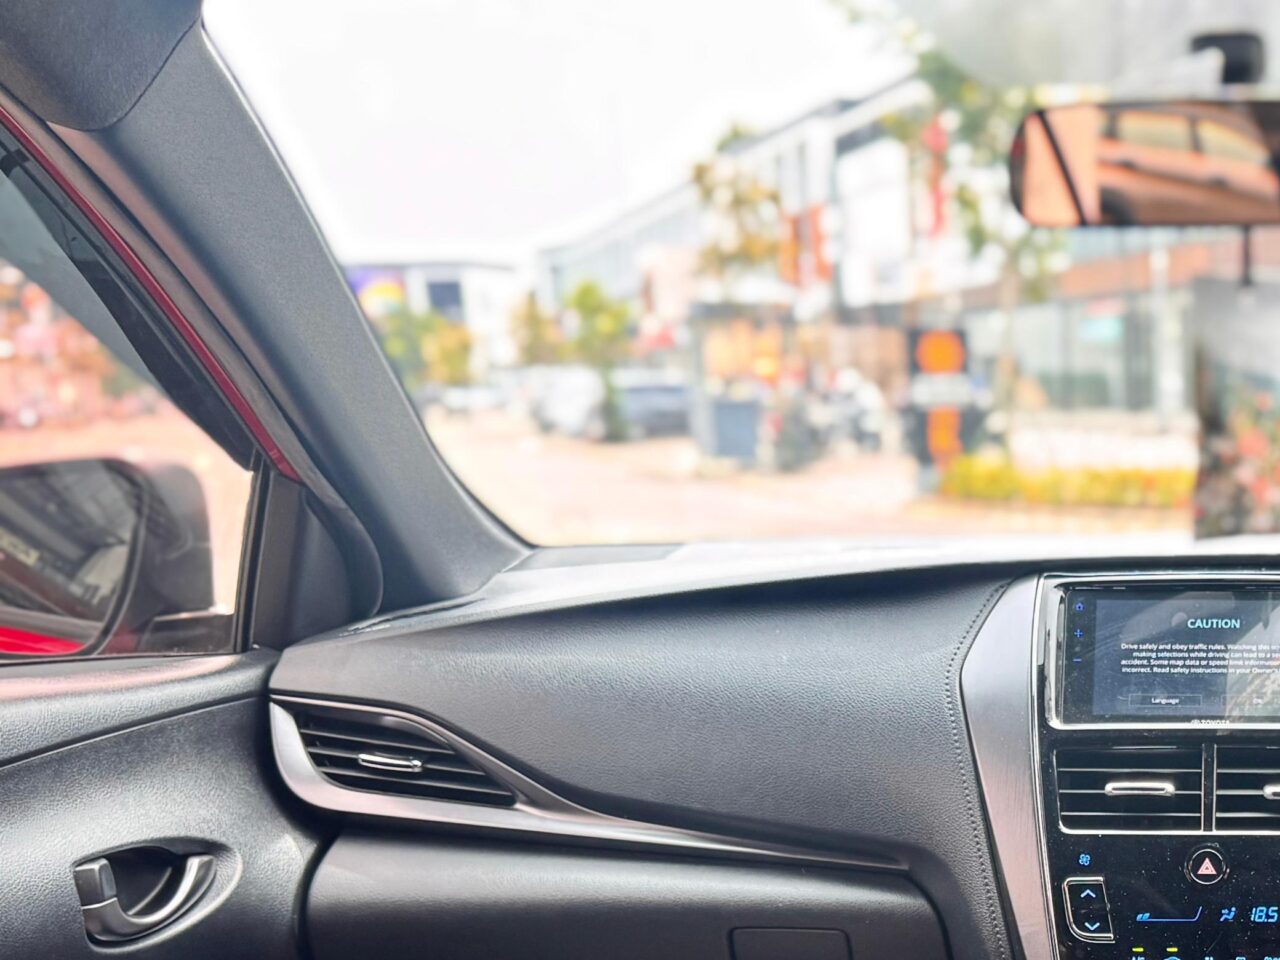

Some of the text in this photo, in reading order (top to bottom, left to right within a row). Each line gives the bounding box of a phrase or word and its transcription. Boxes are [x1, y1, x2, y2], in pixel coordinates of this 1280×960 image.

[1187, 619, 1240, 628] CAUTION
[1139, 643, 1158, 651] safely
[1172, 643, 1188, 651] obey
[1251, 906, 1278, 922] 18.5
